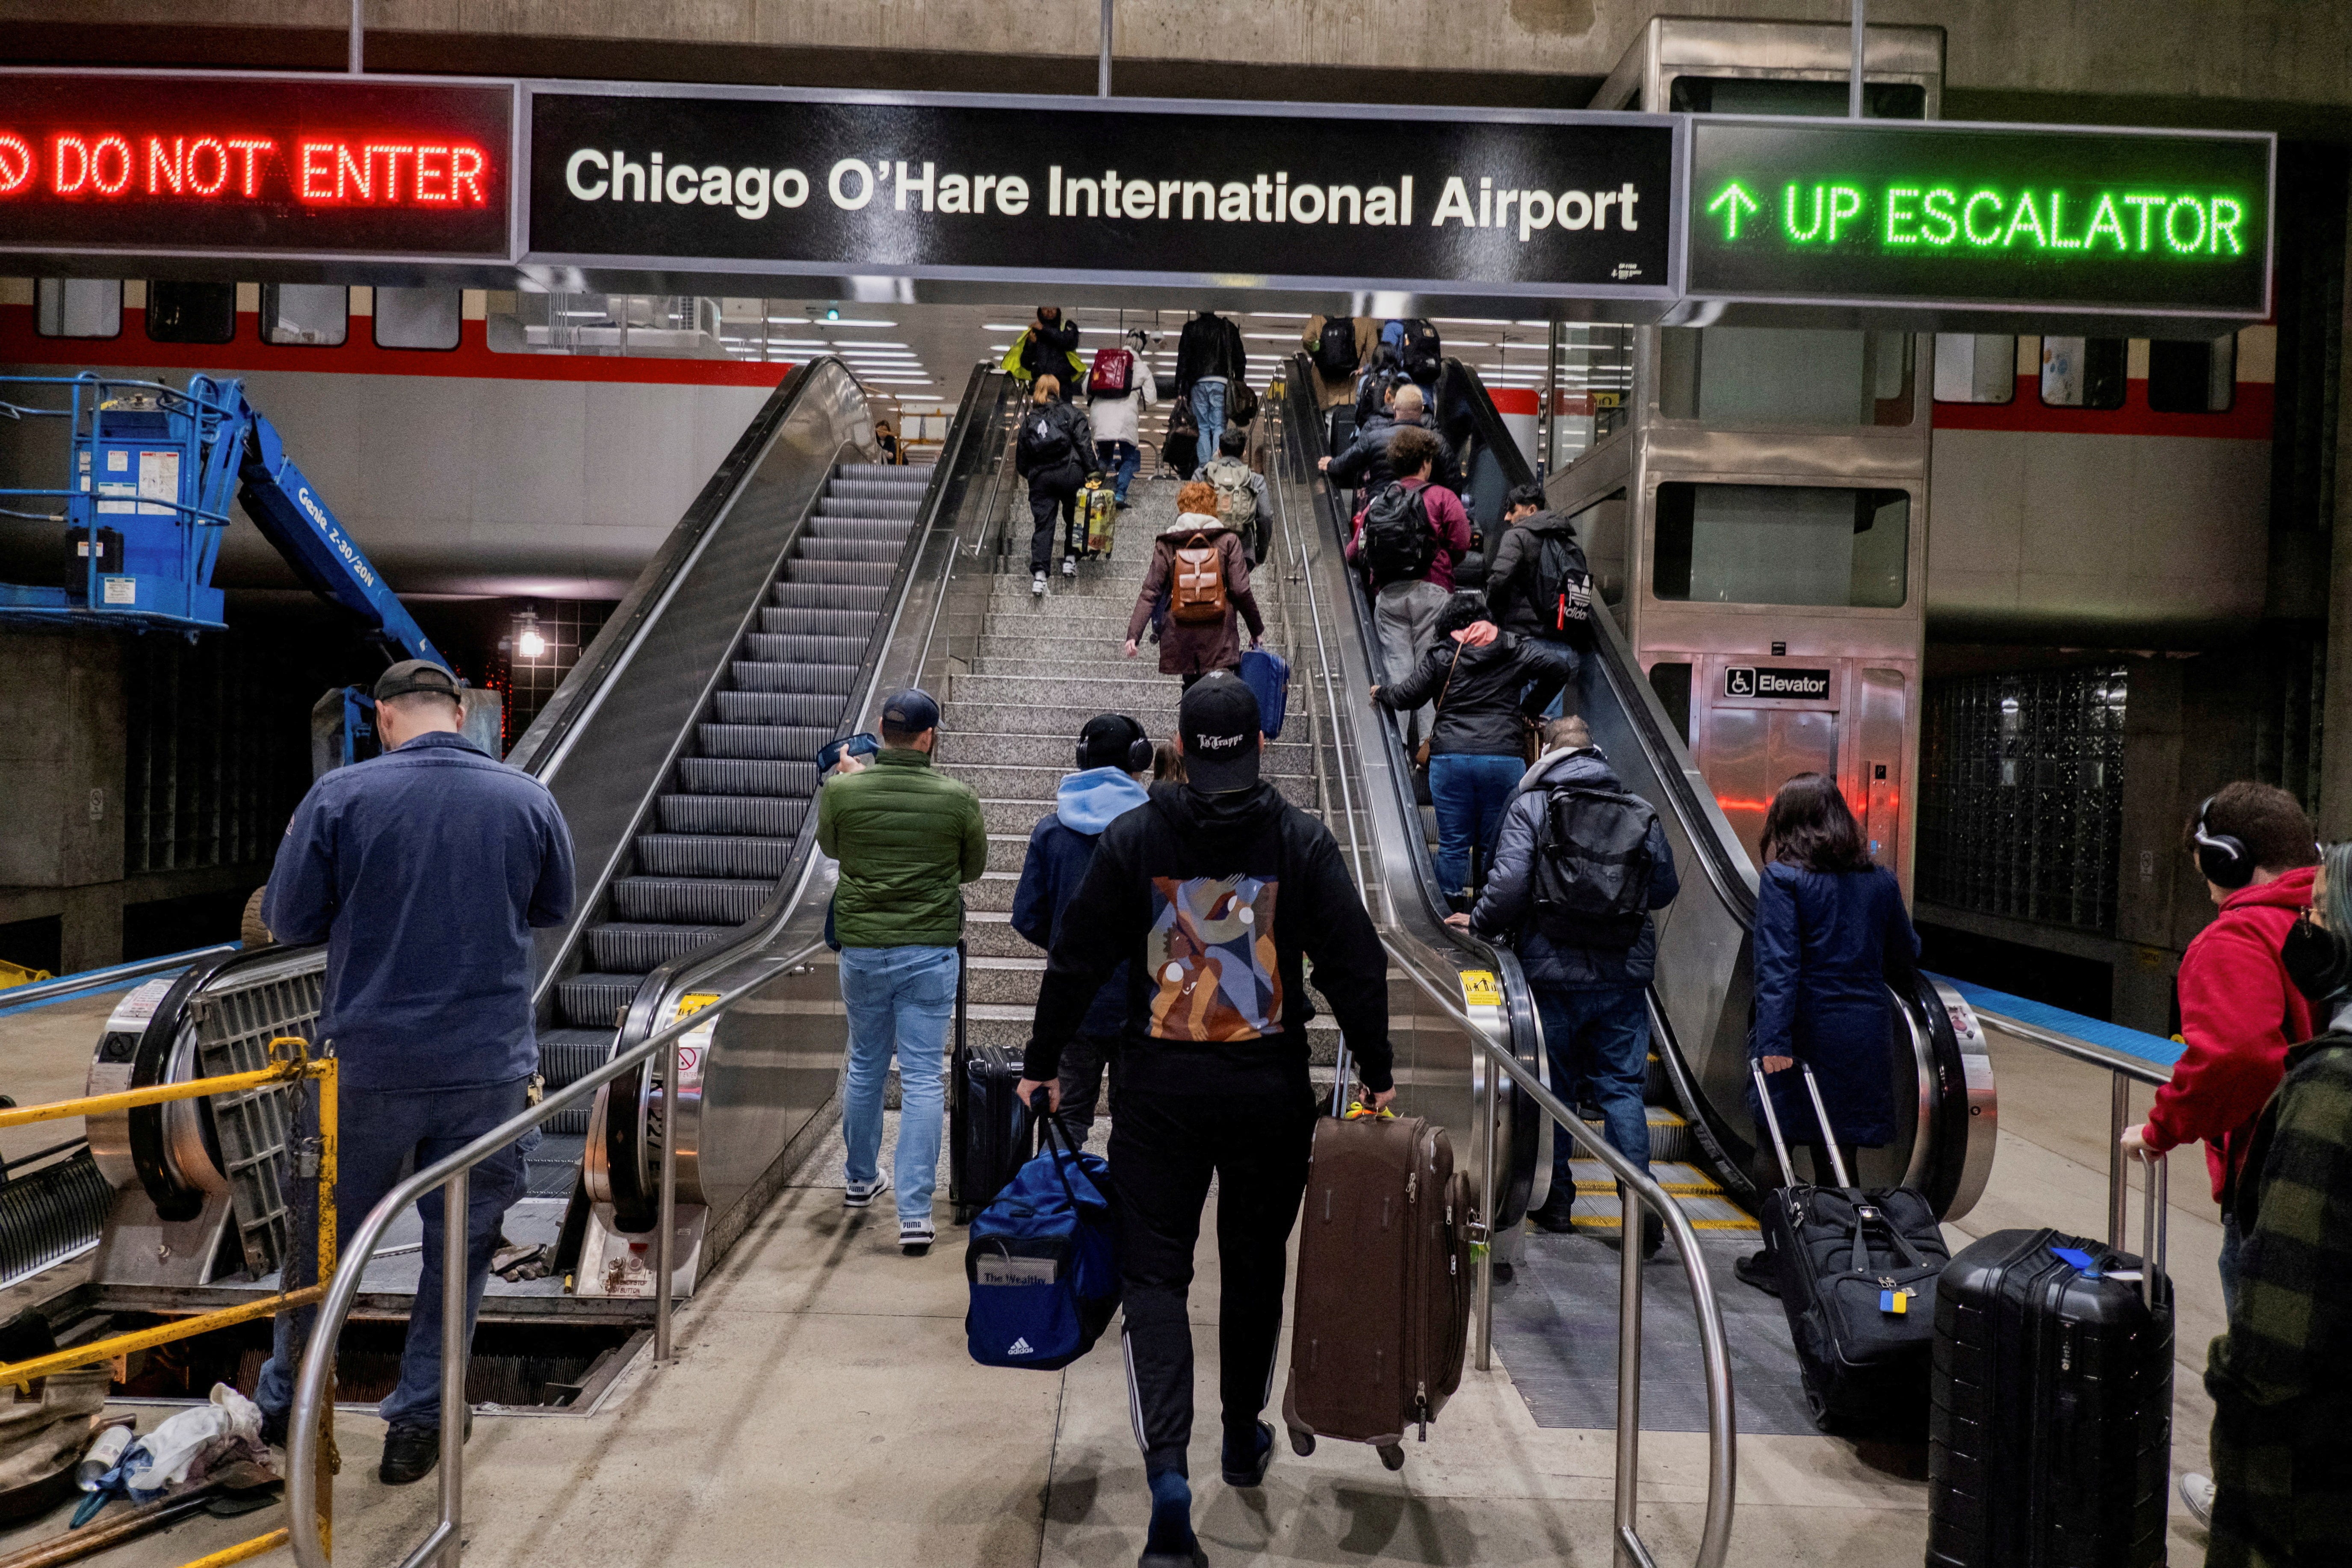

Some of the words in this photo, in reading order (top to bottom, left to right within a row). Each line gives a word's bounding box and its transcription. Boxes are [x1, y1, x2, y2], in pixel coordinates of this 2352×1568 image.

[56, 136, 131, 194] DO
[149, 137, 272, 195] NOT
[302, 142, 484, 202] ENTER
[565, 148, 810, 220] Chicago
[827, 157, 1030, 215] O'Hare
[1048, 165, 1413, 226] International
[1431, 175, 1639, 242] Airport
[1785, 184, 1861, 242] UP
[1886, 188, 2242, 254] ESCALATOR
[298, 487, 328, 532] Genie
[328, 527, 375, 588] Z-30/20N
[1759, 674, 1826, 692] Elevator
[903, 1221, 921, 1229] PUMA
